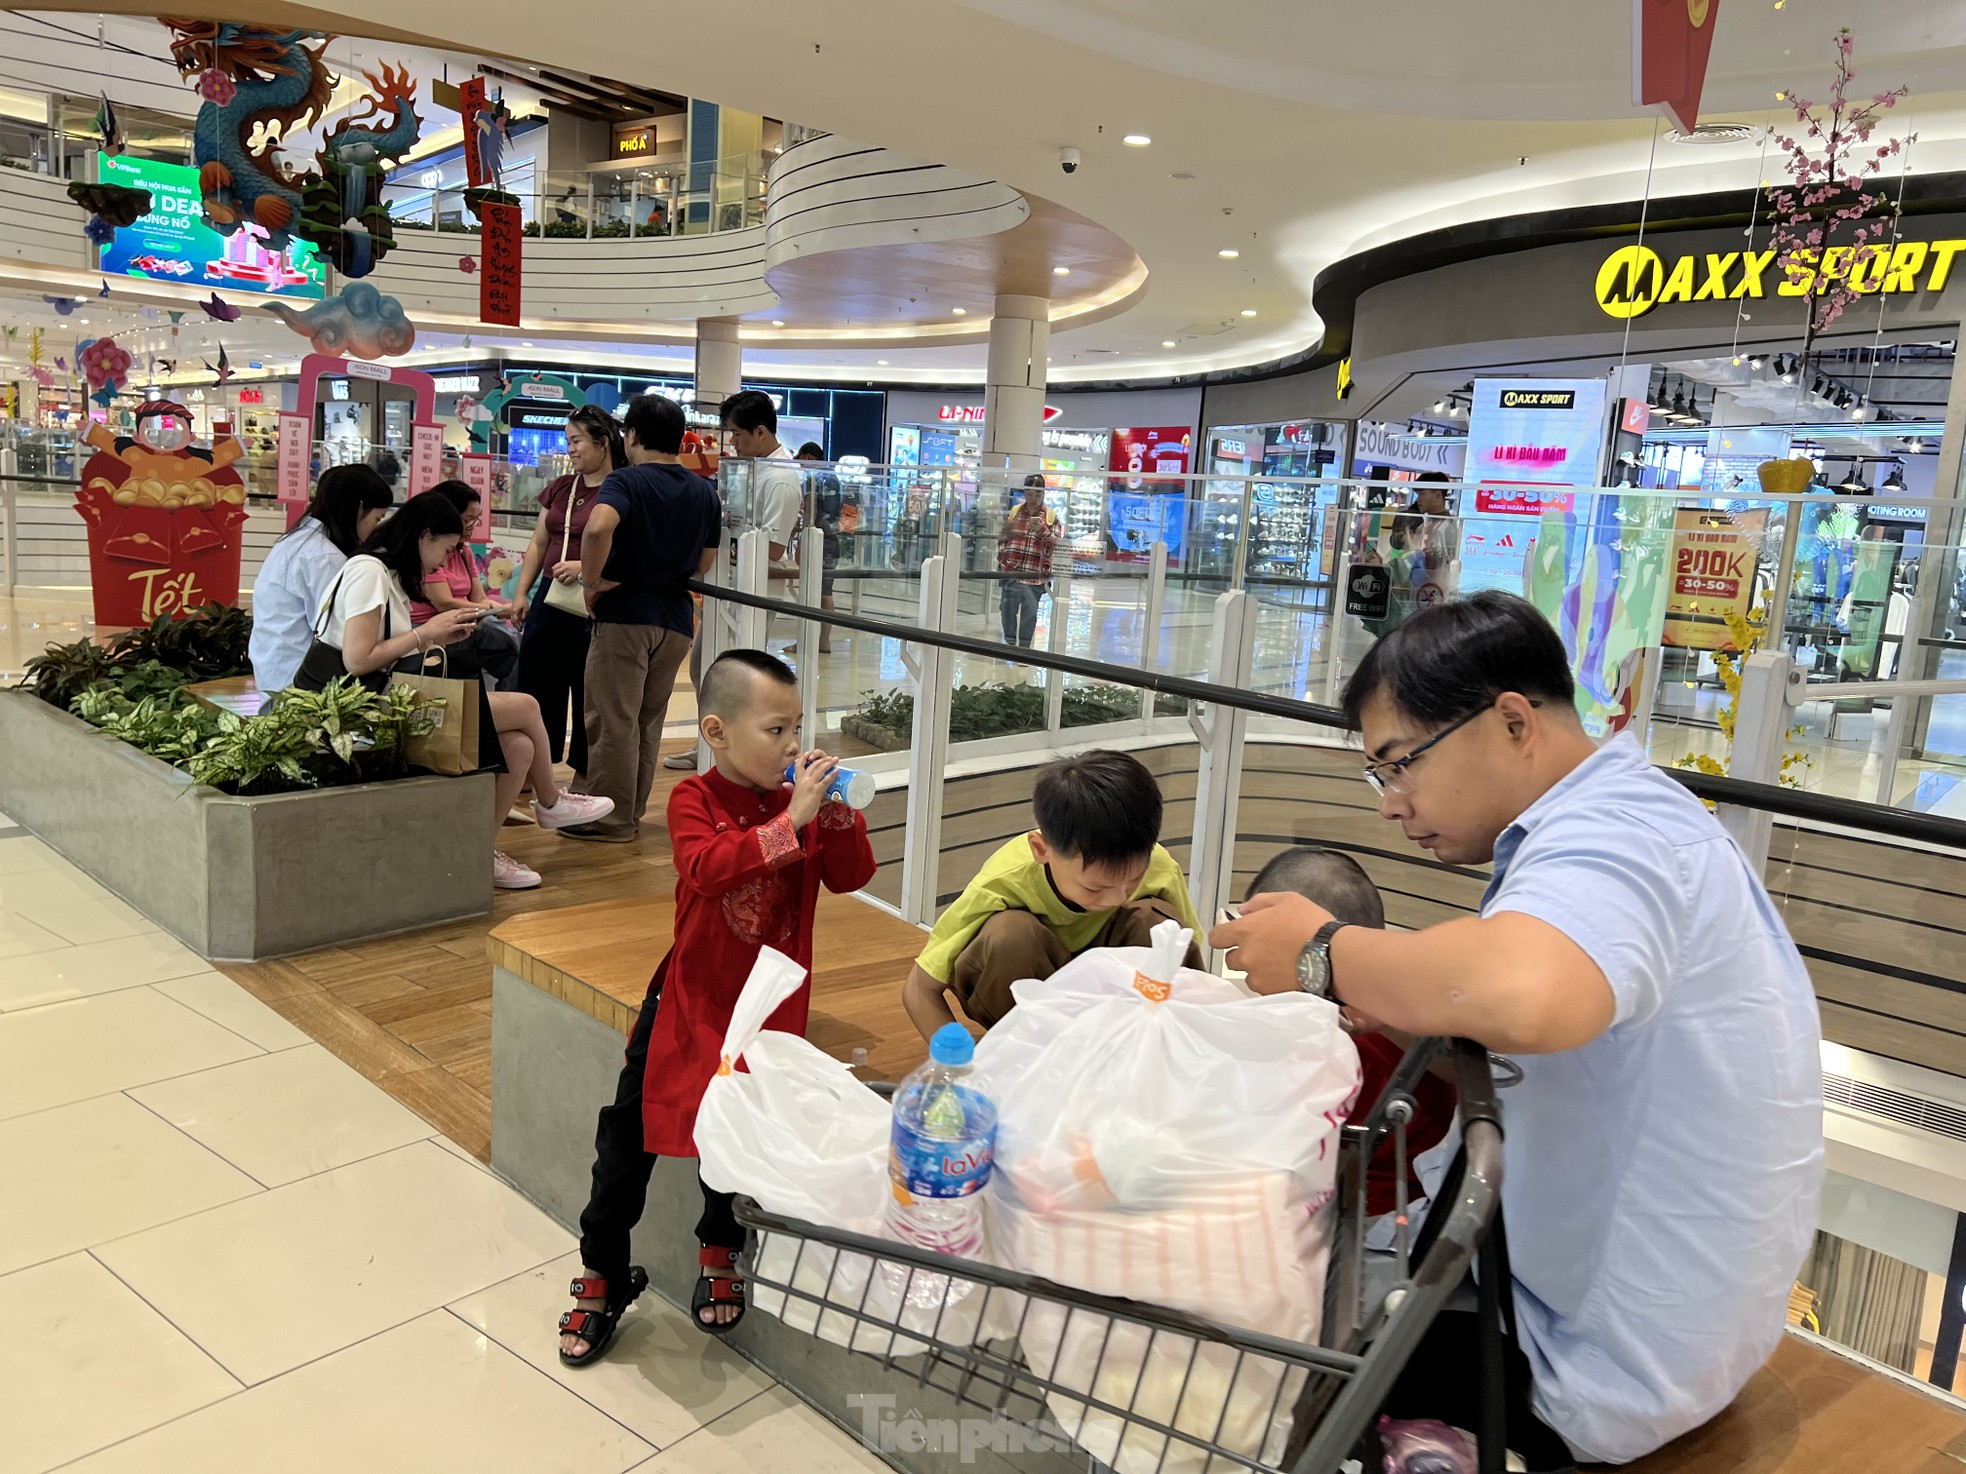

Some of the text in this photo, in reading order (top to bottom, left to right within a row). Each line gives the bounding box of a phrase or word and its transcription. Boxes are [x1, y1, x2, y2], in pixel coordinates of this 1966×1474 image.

[1595, 239, 1966, 318] MAXX SPORT
[331, 380, 349, 400] VANS
[543, 386, 560, 394] MALL
[1504, 391, 1571, 407] MAXX SPORT
[1359, 427, 1400, 457] SOUND
[1898, 507, 1926, 518] ROOM
[1677, 547, 1747, 578] 200K
[127, 568, 203, 623] Tết
[1349, 602, 1367, 611] FREE
[429, 708, 442, 717] UNI
